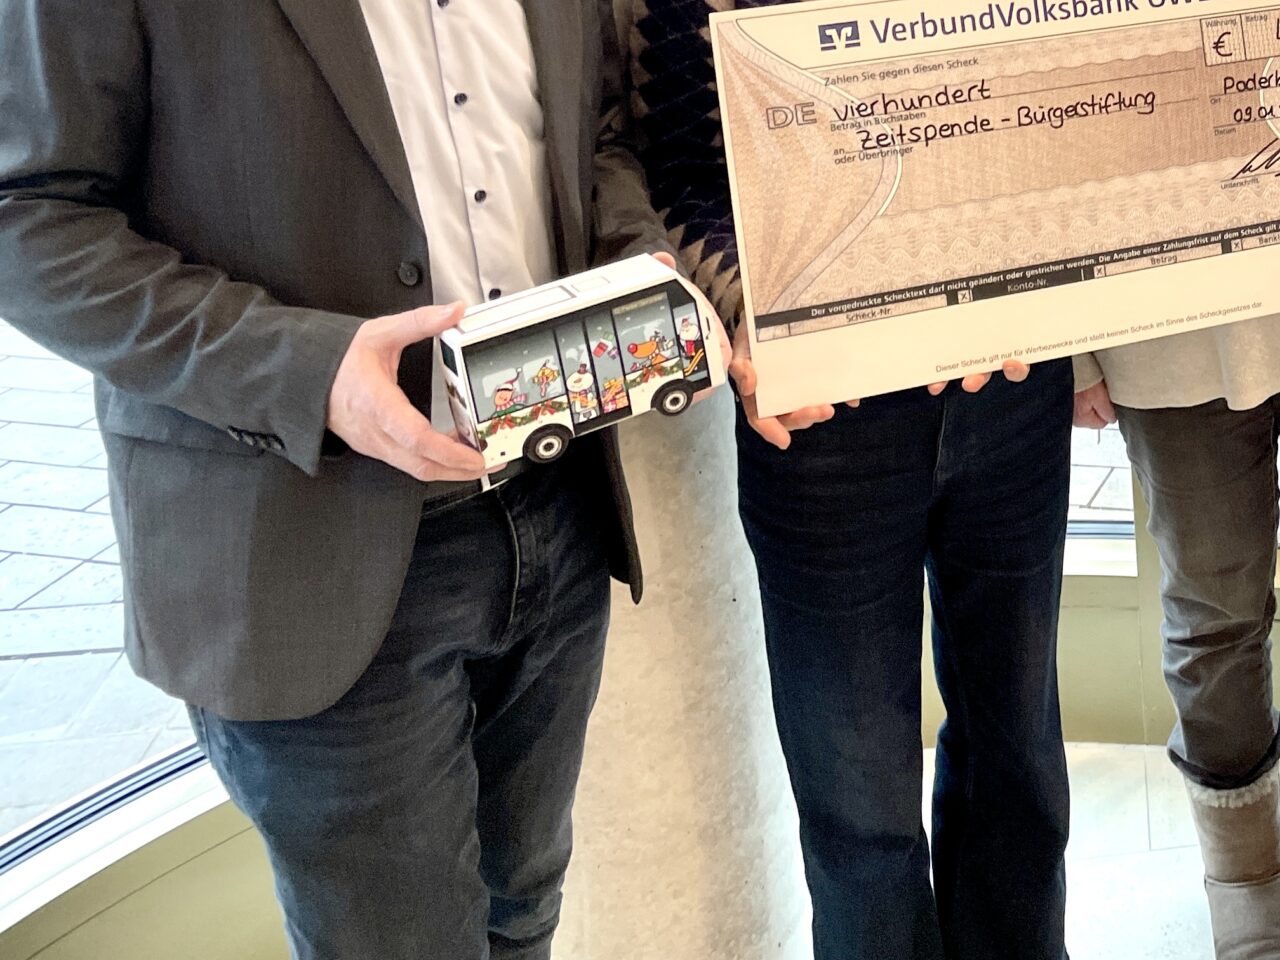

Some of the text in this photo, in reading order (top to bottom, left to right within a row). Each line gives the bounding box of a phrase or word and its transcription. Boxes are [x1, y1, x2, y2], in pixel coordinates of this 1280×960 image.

[1212, 31, 1233, 57] €
[824, 56, 979, 87] Zahlen Sie gegen diesen Scheck
[766, 101, 817, 130] DE
[832, 79, 992, 122] vierhundert
[830, 110, 927, 133] Betrag in Buchstaben
[856, 116, 995, 151] Zeitspende
[833, 148, 846, 157] an
[834, 146, 914, 166] oder Überbringer
[811, 306, 826, 317] Der
[828, 296, 882, 315] vorgedruckte
[883, 288, 927, 304] Schecktext
[928, 284, 946, 295] darf
[947, 280, 967, 292] nicht
[968, 273, 1004, 289] geändert
[1005, 270, 1024, 281] oder
[1025, 263, 1065, 278] gestrichen
[1066, 257, 1097, 270] werden.
[1098, 254, 1111, 264] Die
[1113, 248, 1141, 261] Angabe
[1142, 244, 1161, 255] einer
[1162, 234, 1209, 251] Zahlungsfrist
[1210, 233, 1222, 243] auf
[1223, 231, 1239, 241] dem
[1240, 225, 1264, 238] Scheck
[1265, 222, 1277, 234] gilt
[936, 361, 959, 373] Dieser
[960, 355, 987, 368] Scheck
[988, 352, 1000, 363] gilt
[1000, 351, 1013, 360] nur
[1013, 348, 1024, 357] für
[1025, 339, 1074, 355] Werbezwecke
[1074, 336, 1088, 345] und
[1106, 327, 1129, 337] keinen
[1130, 322, 1155, 333] Scheck
[1156, 320, 1165, 329] im
[1165, 316, 1185, 327] Sinne
[1185, 313, 1198, 323] des
